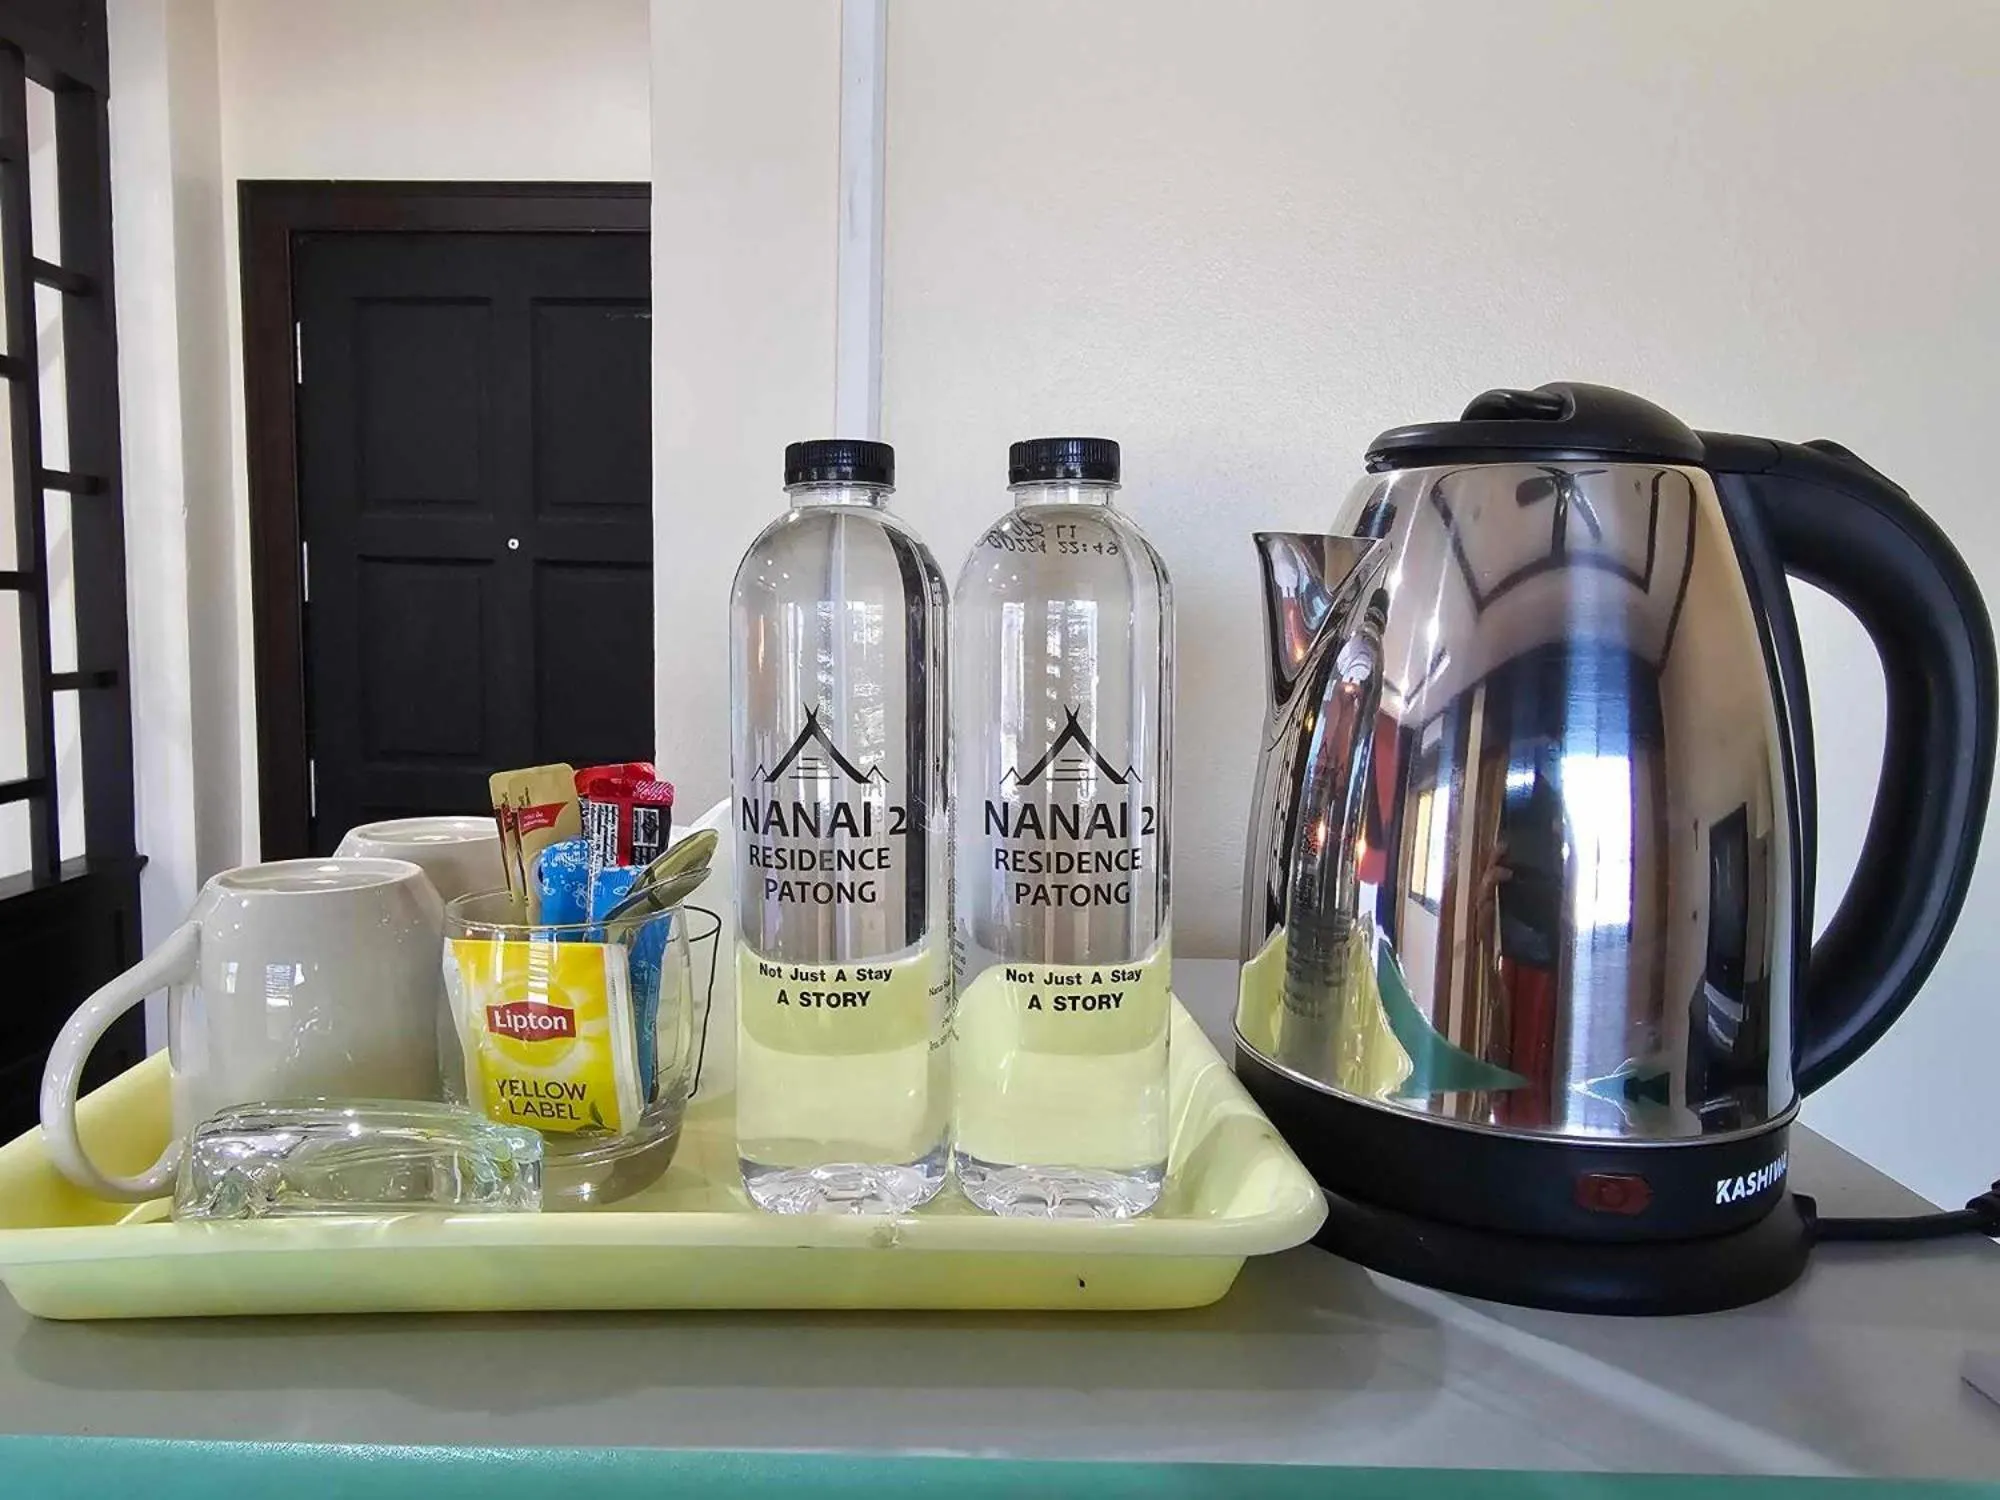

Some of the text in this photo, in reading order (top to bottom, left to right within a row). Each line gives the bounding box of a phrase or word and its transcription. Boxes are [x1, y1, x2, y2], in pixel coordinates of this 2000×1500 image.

[742, 796, 908, 838] NANAI 2
[984, 800, 1156, 840] NANAI 2
[750, 844, 892, 872] RESIDENCE
[995, 847, 1142, 875] RESIDENCE
[764, 878, 877, 904] PATONG
[1015, 881, 1131, 907] PATONG
[759, 962, 893, 982] Not Just A Stay
[1006, 968, 1142, 986] Not Just A Stay
[777, 989, 871, 1008] A STORY
[1027, 992, 1124, 1012] A STORY
[493, 1009, 568, 1033] Lipton
[495, 1078, 587, 1101] YELLOW
[508, 1099, 581, 1120] LABEL
[1715, 1150, 1788, 1205] KASHIW
